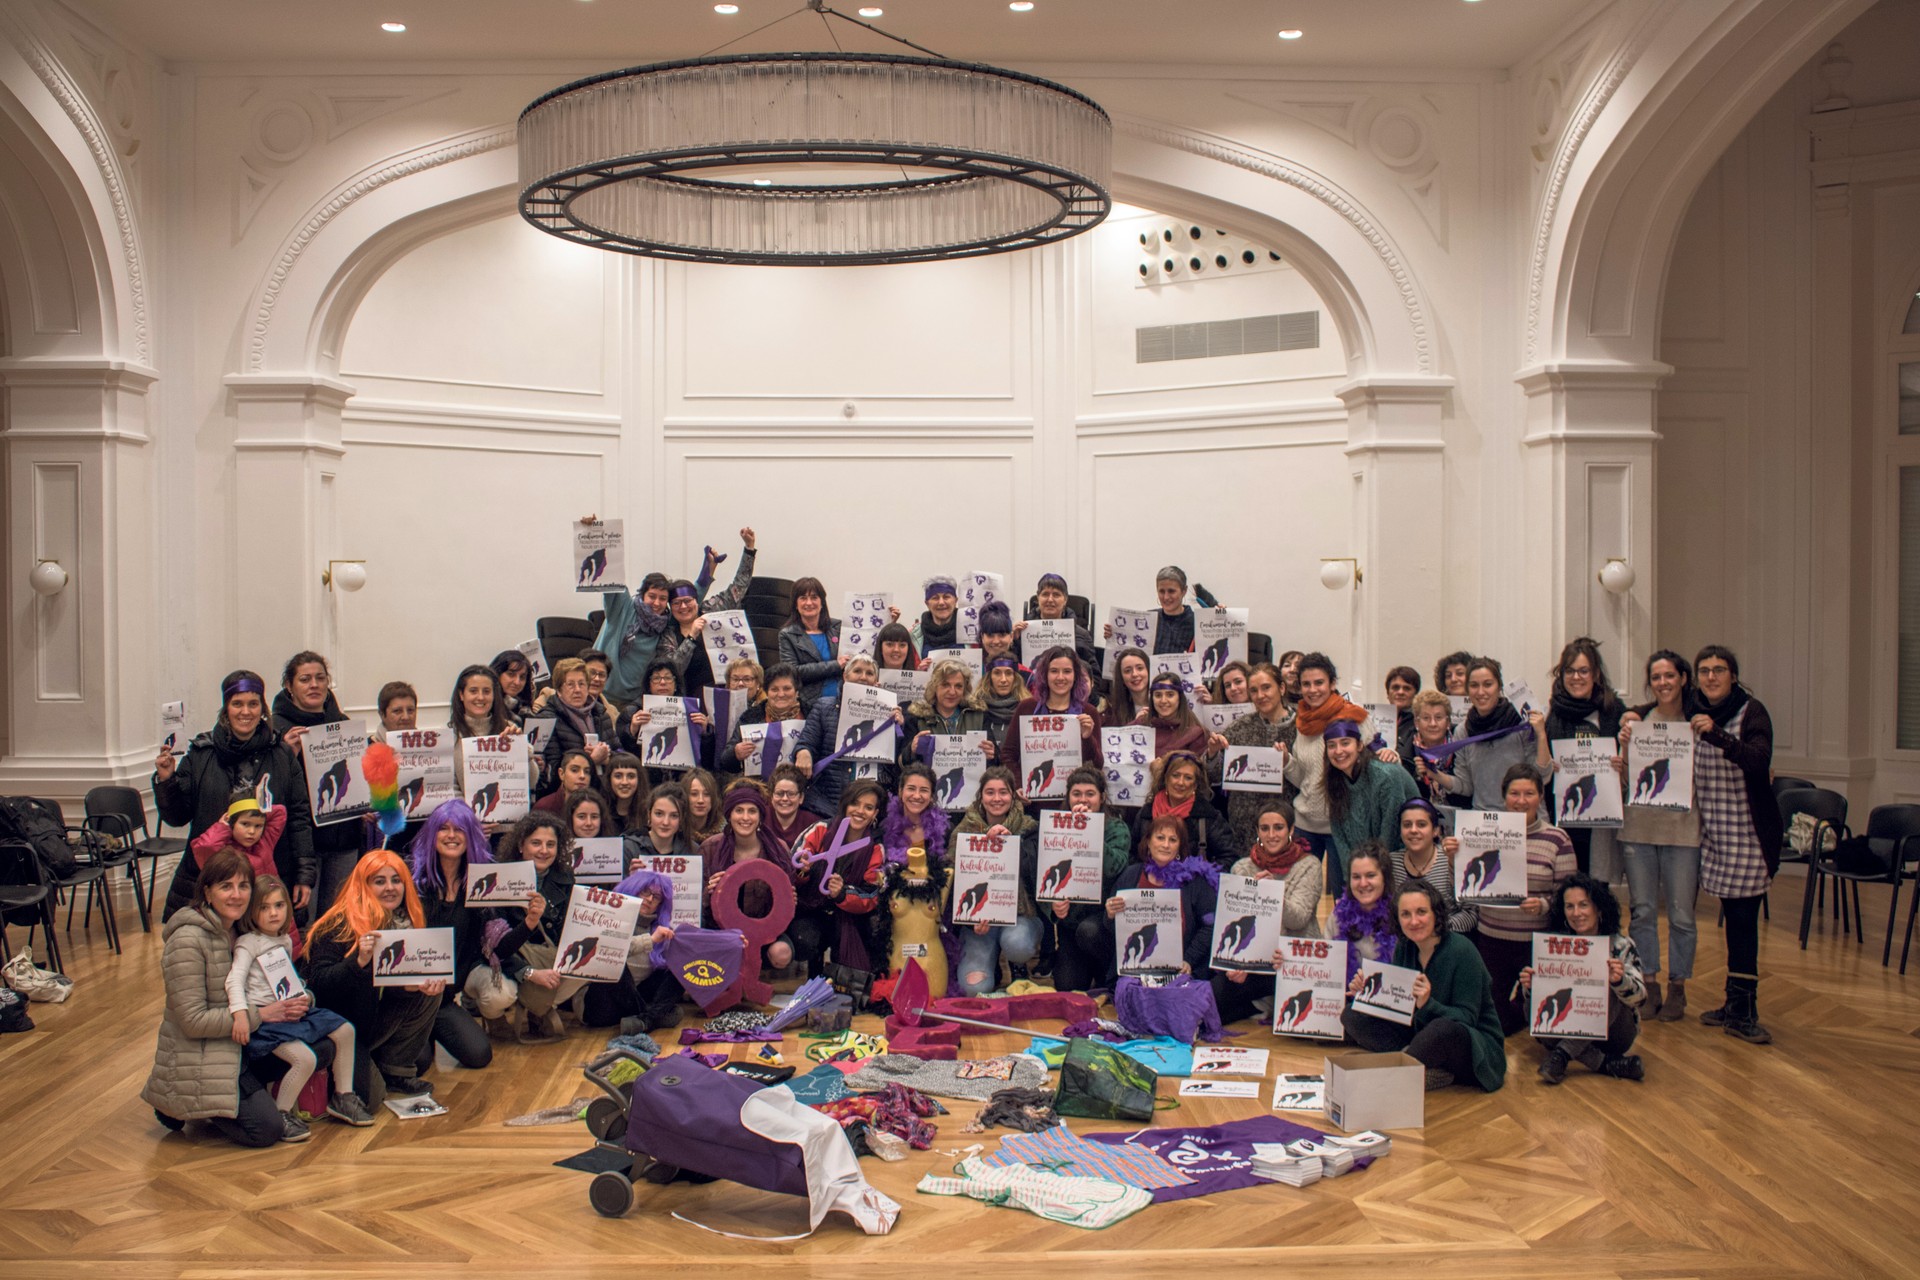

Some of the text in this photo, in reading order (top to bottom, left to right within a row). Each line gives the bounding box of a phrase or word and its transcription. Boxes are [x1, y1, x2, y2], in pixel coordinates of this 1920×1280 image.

[326, 724, 340, 732] M8
[1032, 716, 1065, 732] M8
[401, 731, 437, 748] M8
[477, 737, 511, 752] M8
[398, 754, 418, 768] aleak
[1053, 812, 1087, 830] M8
[969, 835, 1003, 853] M8
[652, 857, 686, 873] M8
[1245, 878, 1258, 887] M8
[586, 886, 624, 909] M8
[1292, 939, 1328, 958] M8
[1548, 936, 1589, 956] M8
